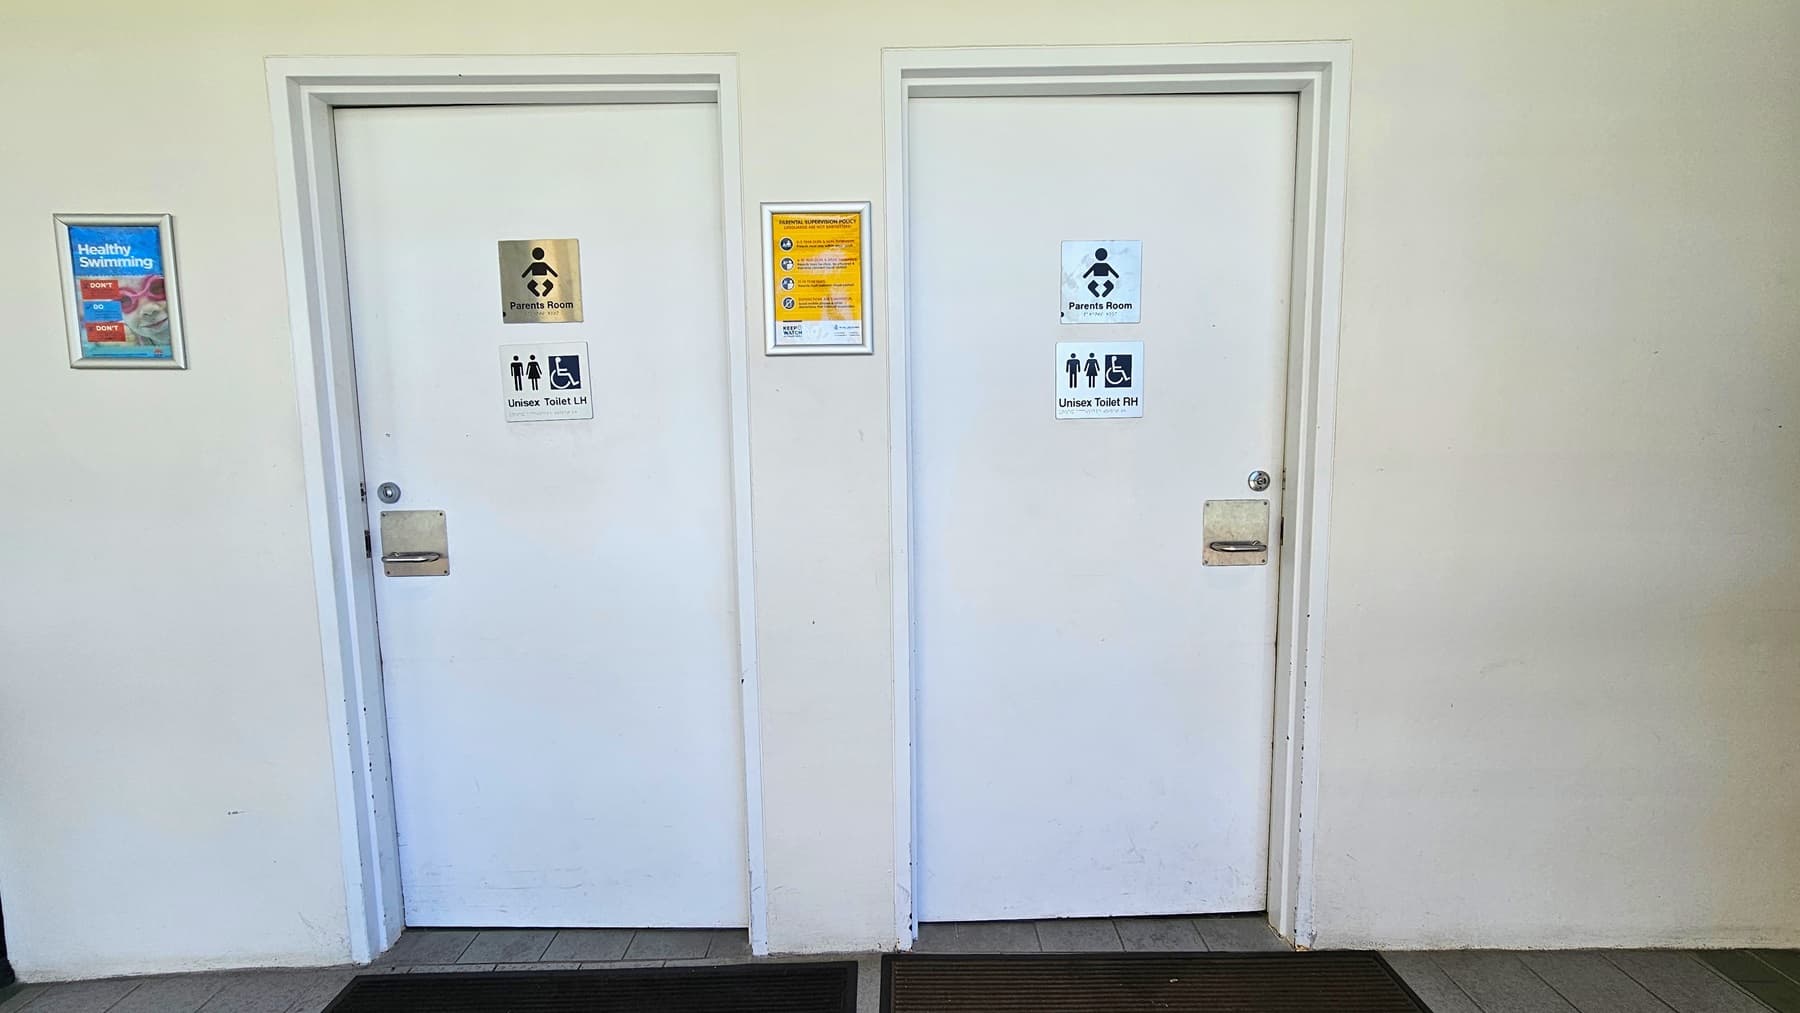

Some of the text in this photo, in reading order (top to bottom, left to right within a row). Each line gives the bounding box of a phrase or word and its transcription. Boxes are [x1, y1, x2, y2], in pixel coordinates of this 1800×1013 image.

[78, 243, 131, 256] Healthy
[80, 256, 153, 269] Swimming
[510, 301, 574, 310] Parents Room
[1068, 302, 1132, 310] Parents Room
[508, 396, 588, 408] Unisex Toilet LH
[1059, 396, 1138, 408] Unisex Toilet RH
